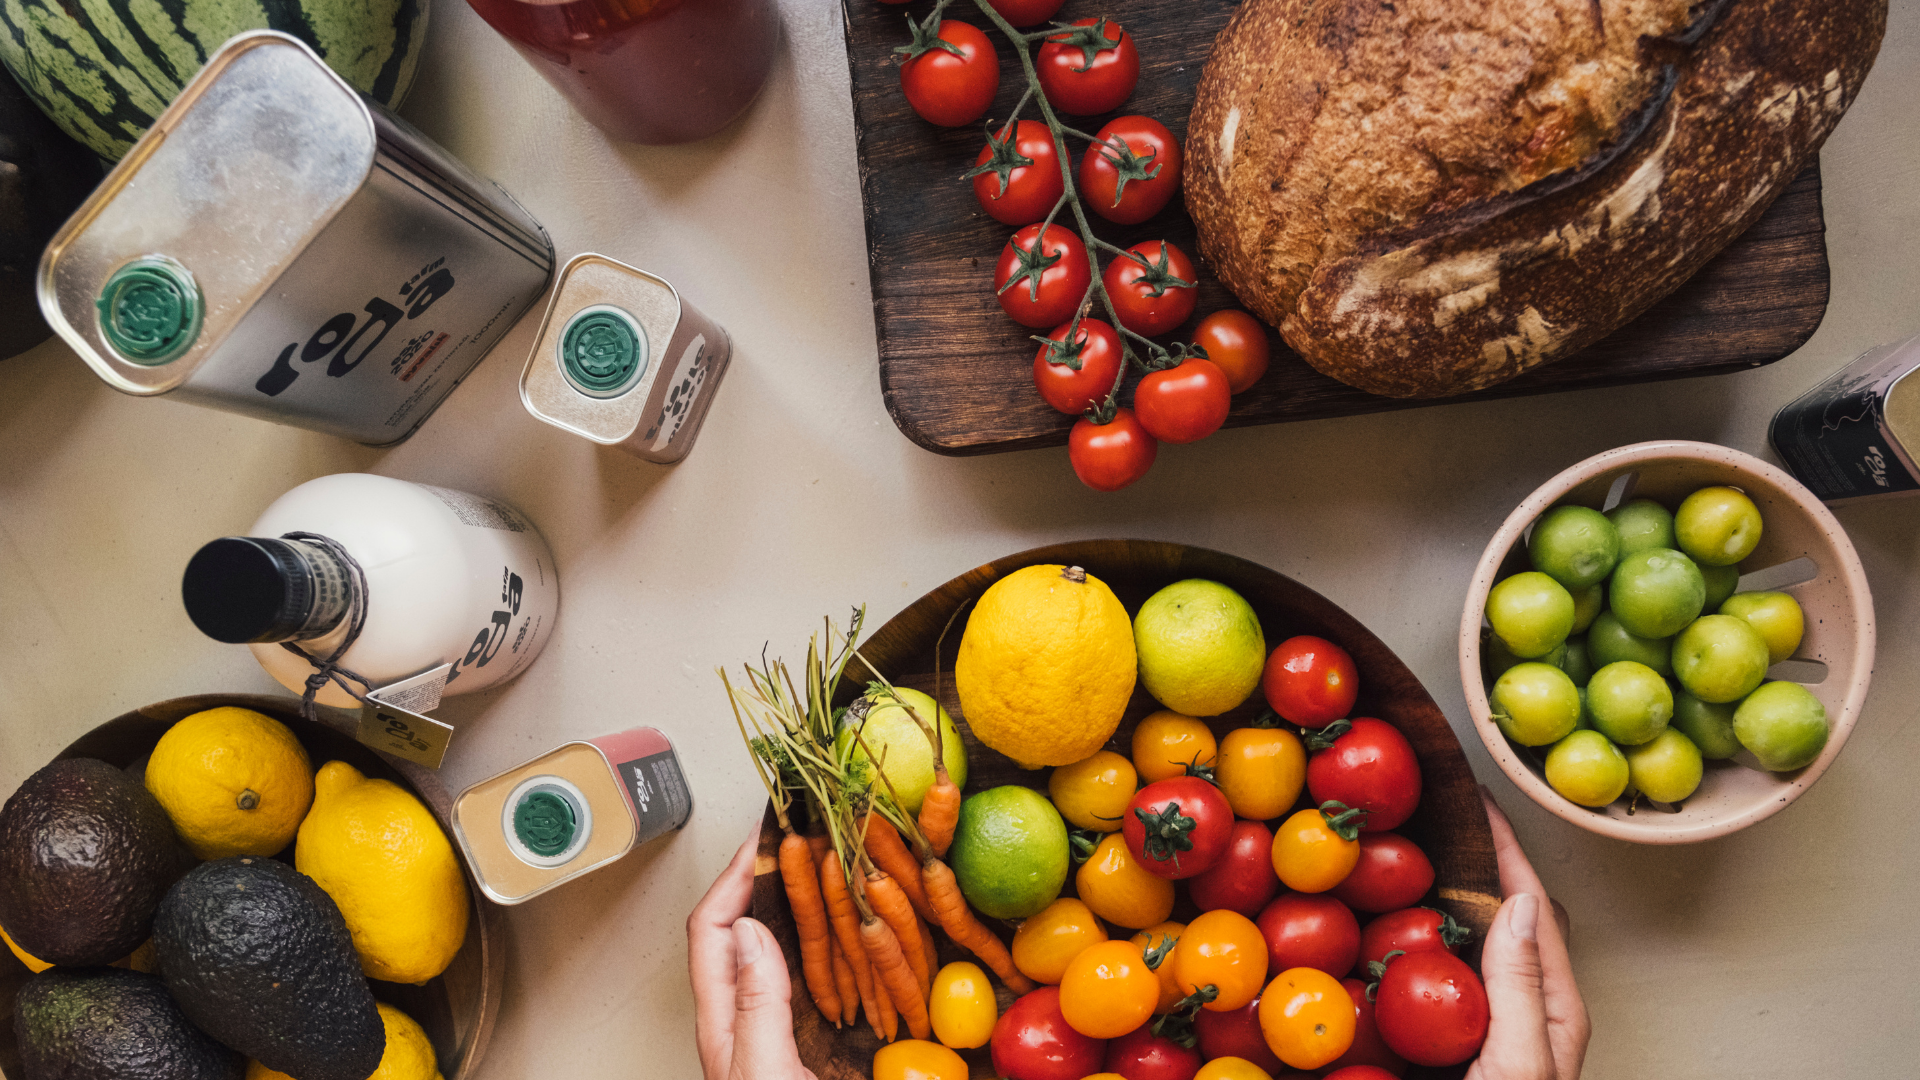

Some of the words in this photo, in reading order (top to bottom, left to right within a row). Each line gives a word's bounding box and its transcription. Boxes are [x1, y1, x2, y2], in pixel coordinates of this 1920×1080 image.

[399, 256, 446, 296] farm
[255, 267, 456, 397] roda
[390, 330, 435, 376] 2020
[1864, 446, 1886, 487] roda
[376, 712, 429, 752] roda
[635, 767, 650, 813] roda
